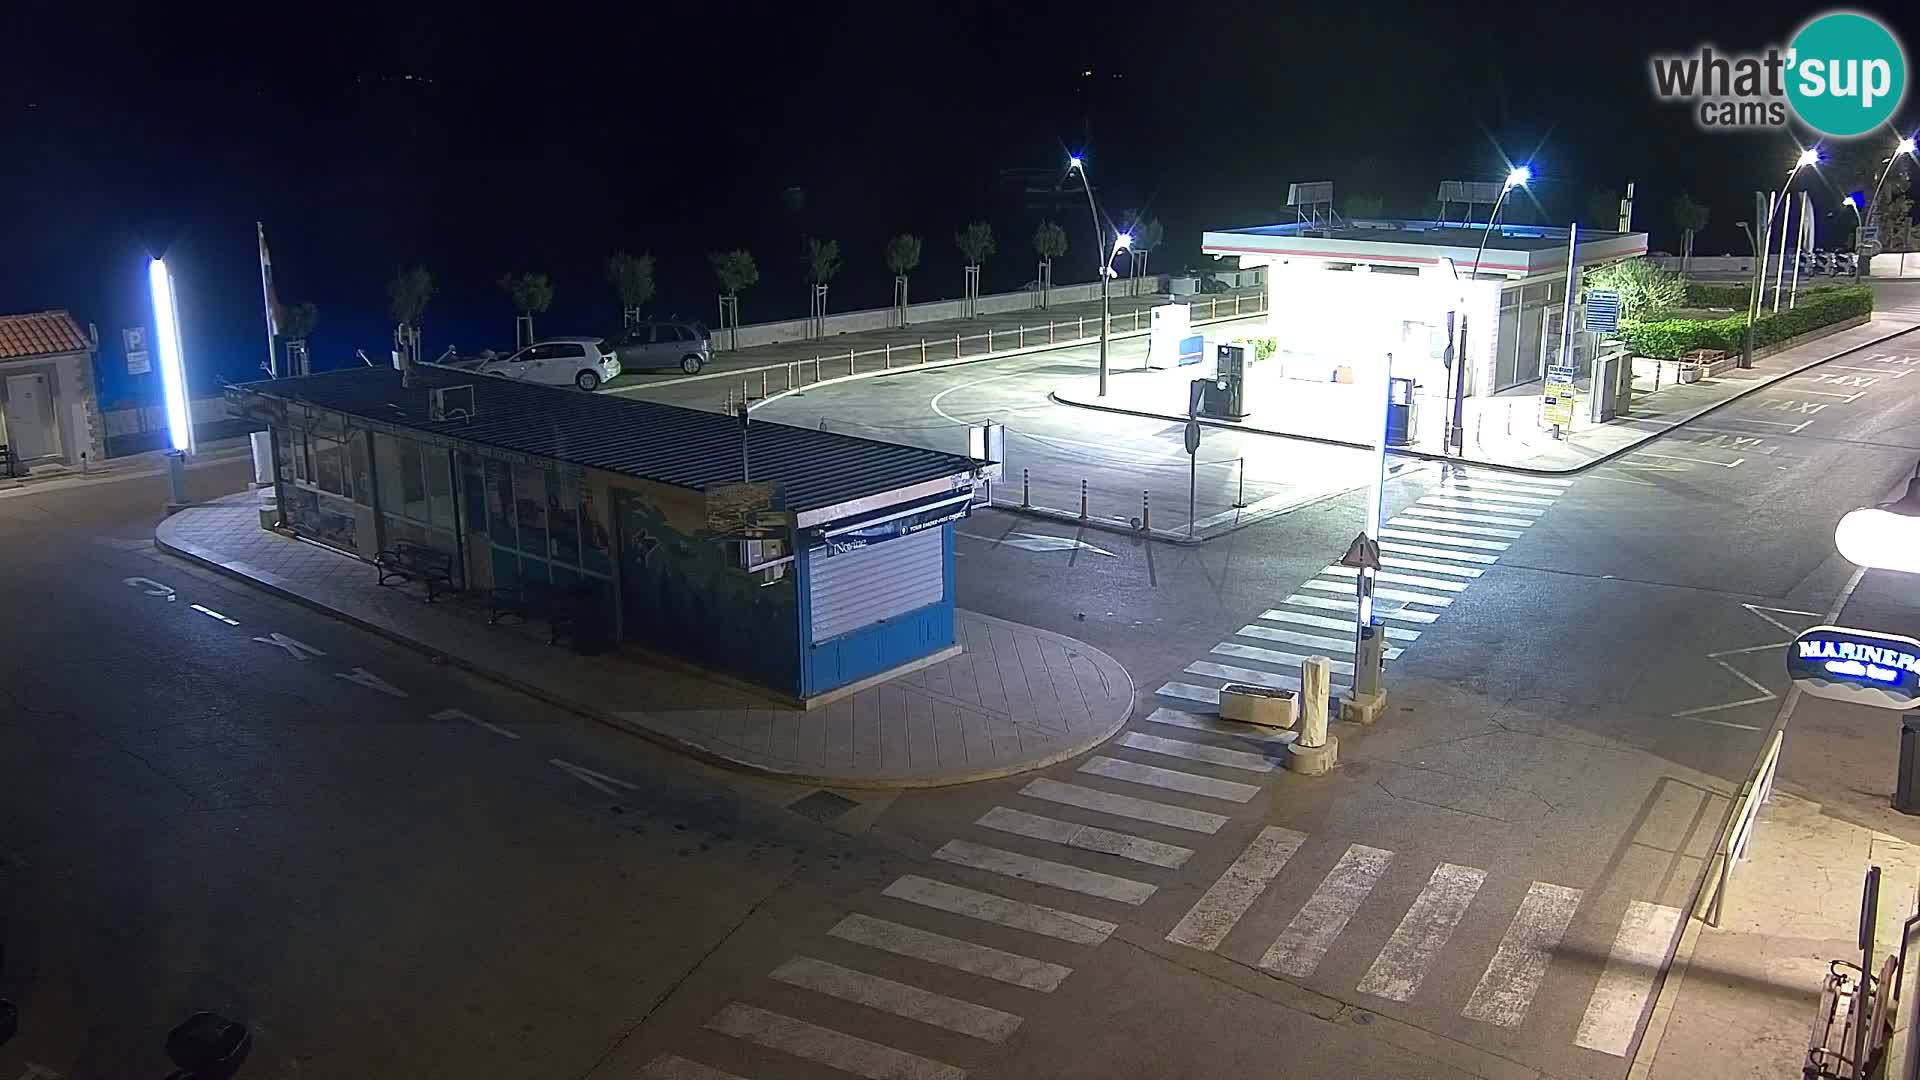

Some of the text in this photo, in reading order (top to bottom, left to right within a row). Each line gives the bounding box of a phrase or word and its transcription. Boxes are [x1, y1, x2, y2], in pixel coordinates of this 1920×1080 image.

[129, 331, 141, 350] P
[1813, 373, 1880, 388] TAXI
[1759, 400, 1829, 414] TAXI
